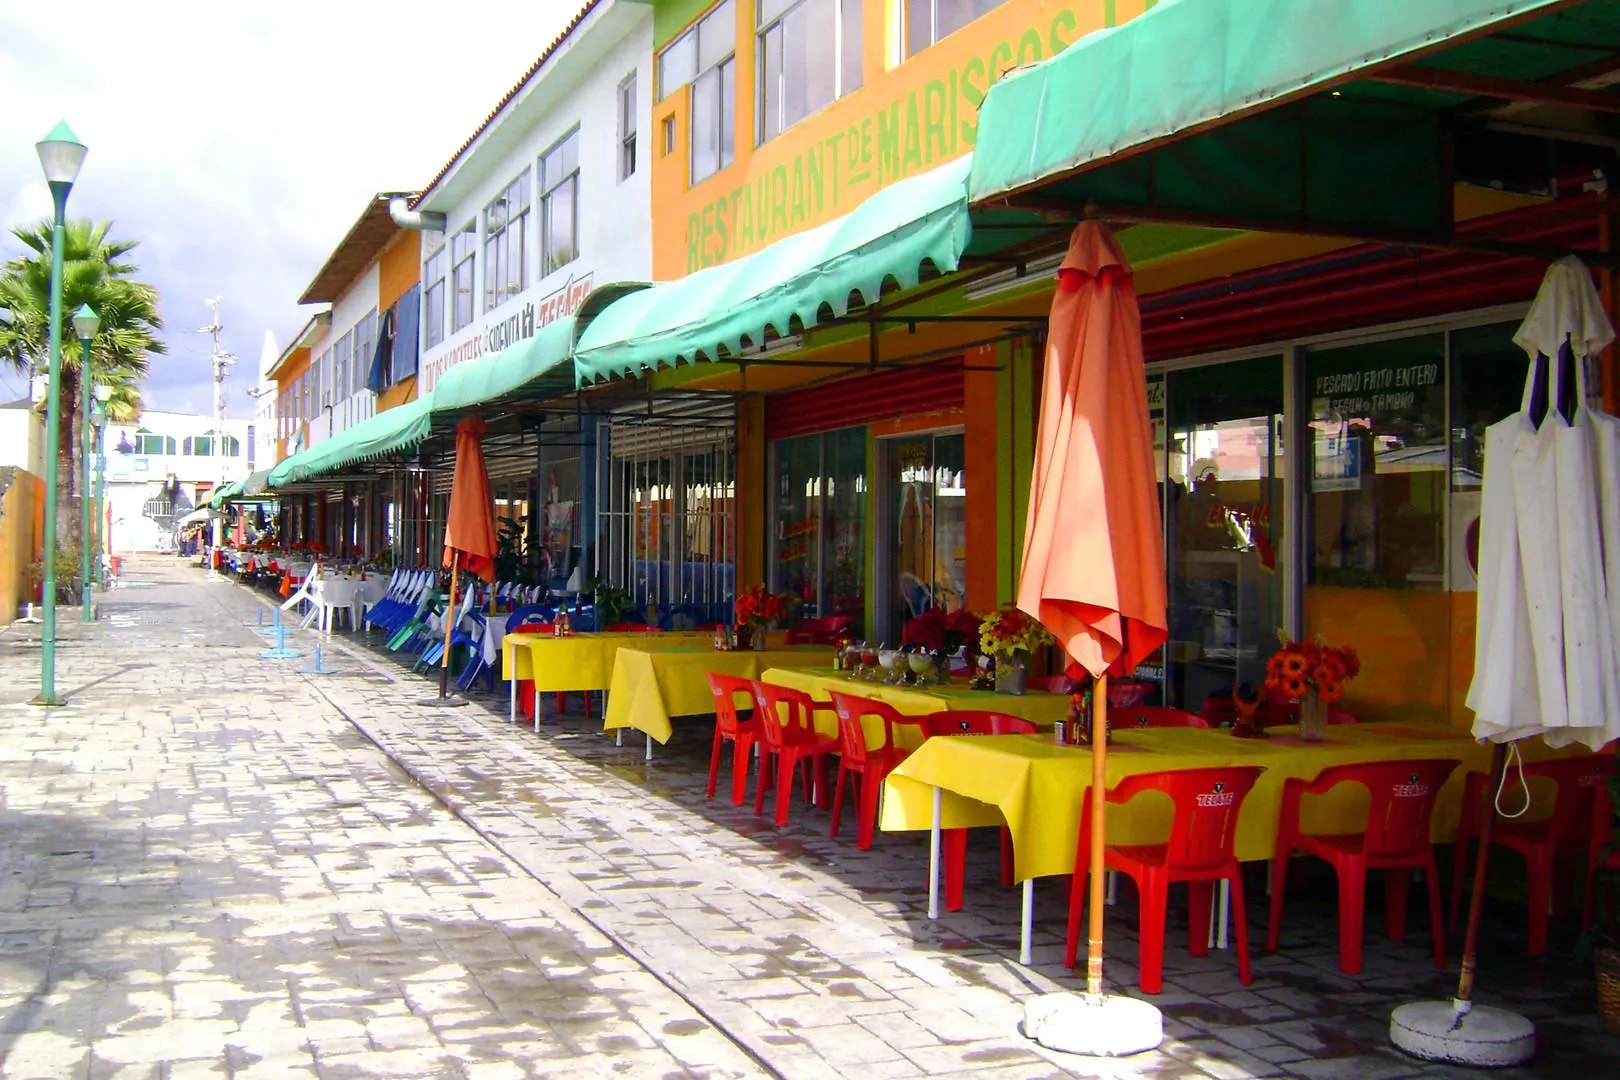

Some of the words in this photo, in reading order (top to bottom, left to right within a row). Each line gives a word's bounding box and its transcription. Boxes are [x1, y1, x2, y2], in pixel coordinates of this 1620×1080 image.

[687, 131, 845, 273] RESTAURANT
[848, 118, 872, 172] DE
[1316, 371, 1361, 394] PESCADO
[1396, 364, 1438, 387] ENTERO
[1196, 792, 1234, 806] TECATE
